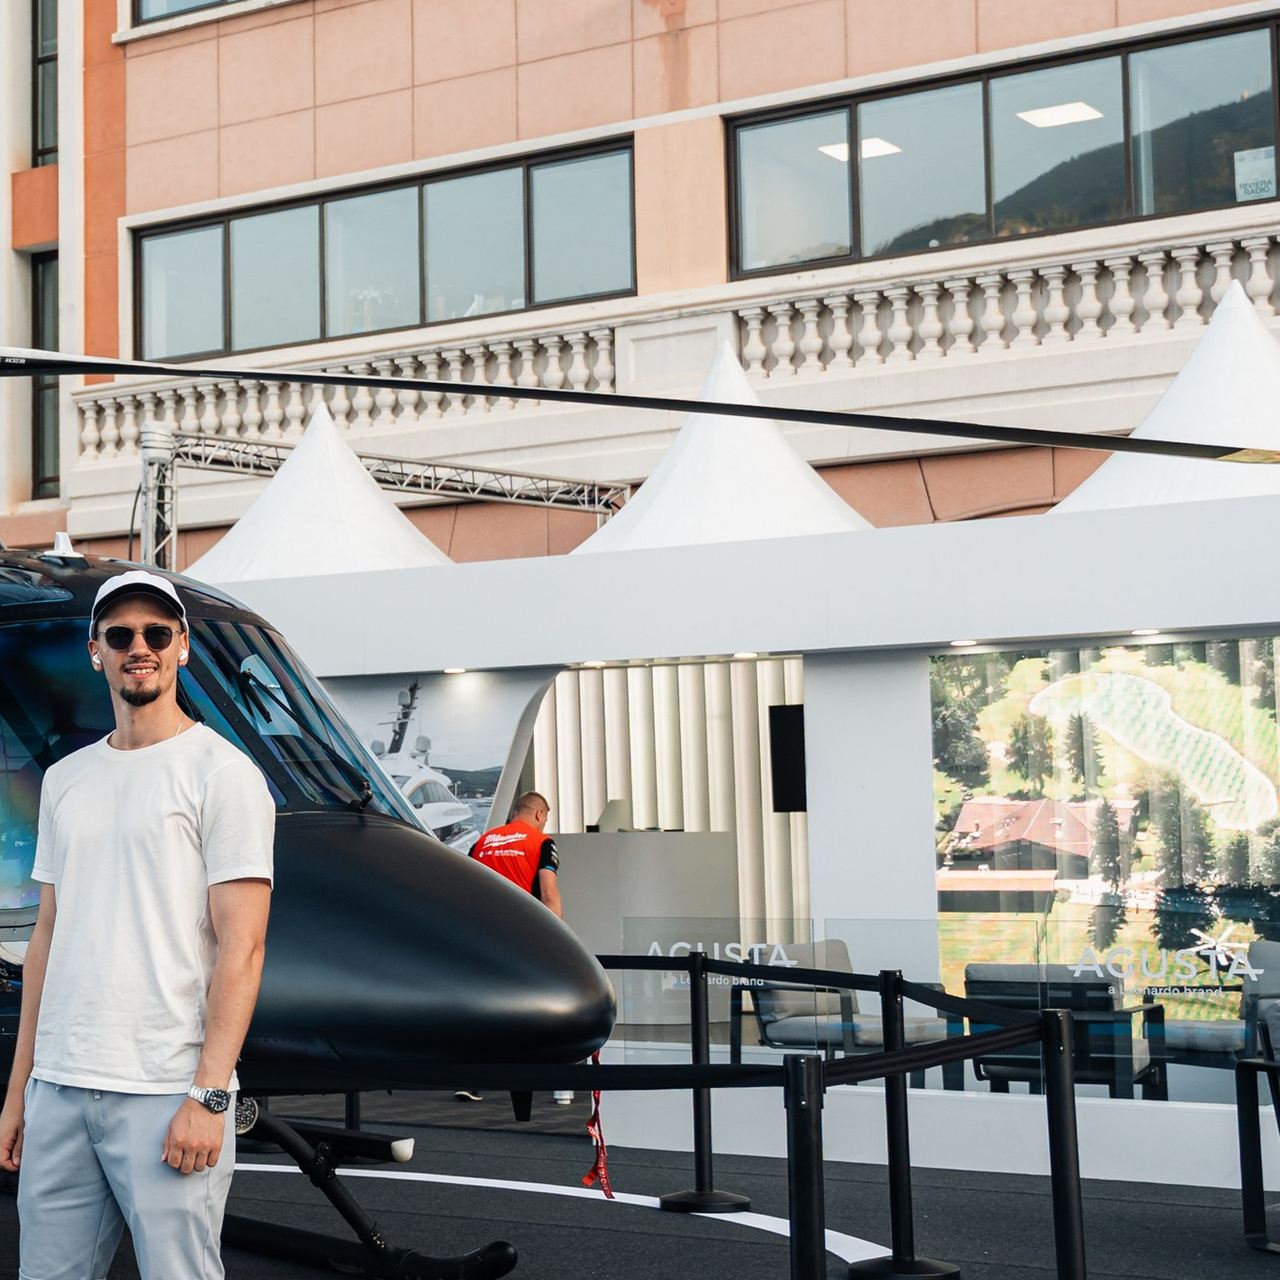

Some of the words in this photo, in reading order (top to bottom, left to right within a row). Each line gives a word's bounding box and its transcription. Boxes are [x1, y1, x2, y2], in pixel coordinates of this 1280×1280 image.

[1239, 179, 1272, 190] RIVIERA
[1244, 186, 1270, 196] RADIO
[1067, 947, 1265, 982] AGUSTA
[670, 976, 676, 984] a
[680, 974, 729, 986] Leardo
[1108, 986, 1115, 995] a
[1119, 985, 1180, 996] Leonardo
[1184, 986, 1222, 997] brand
